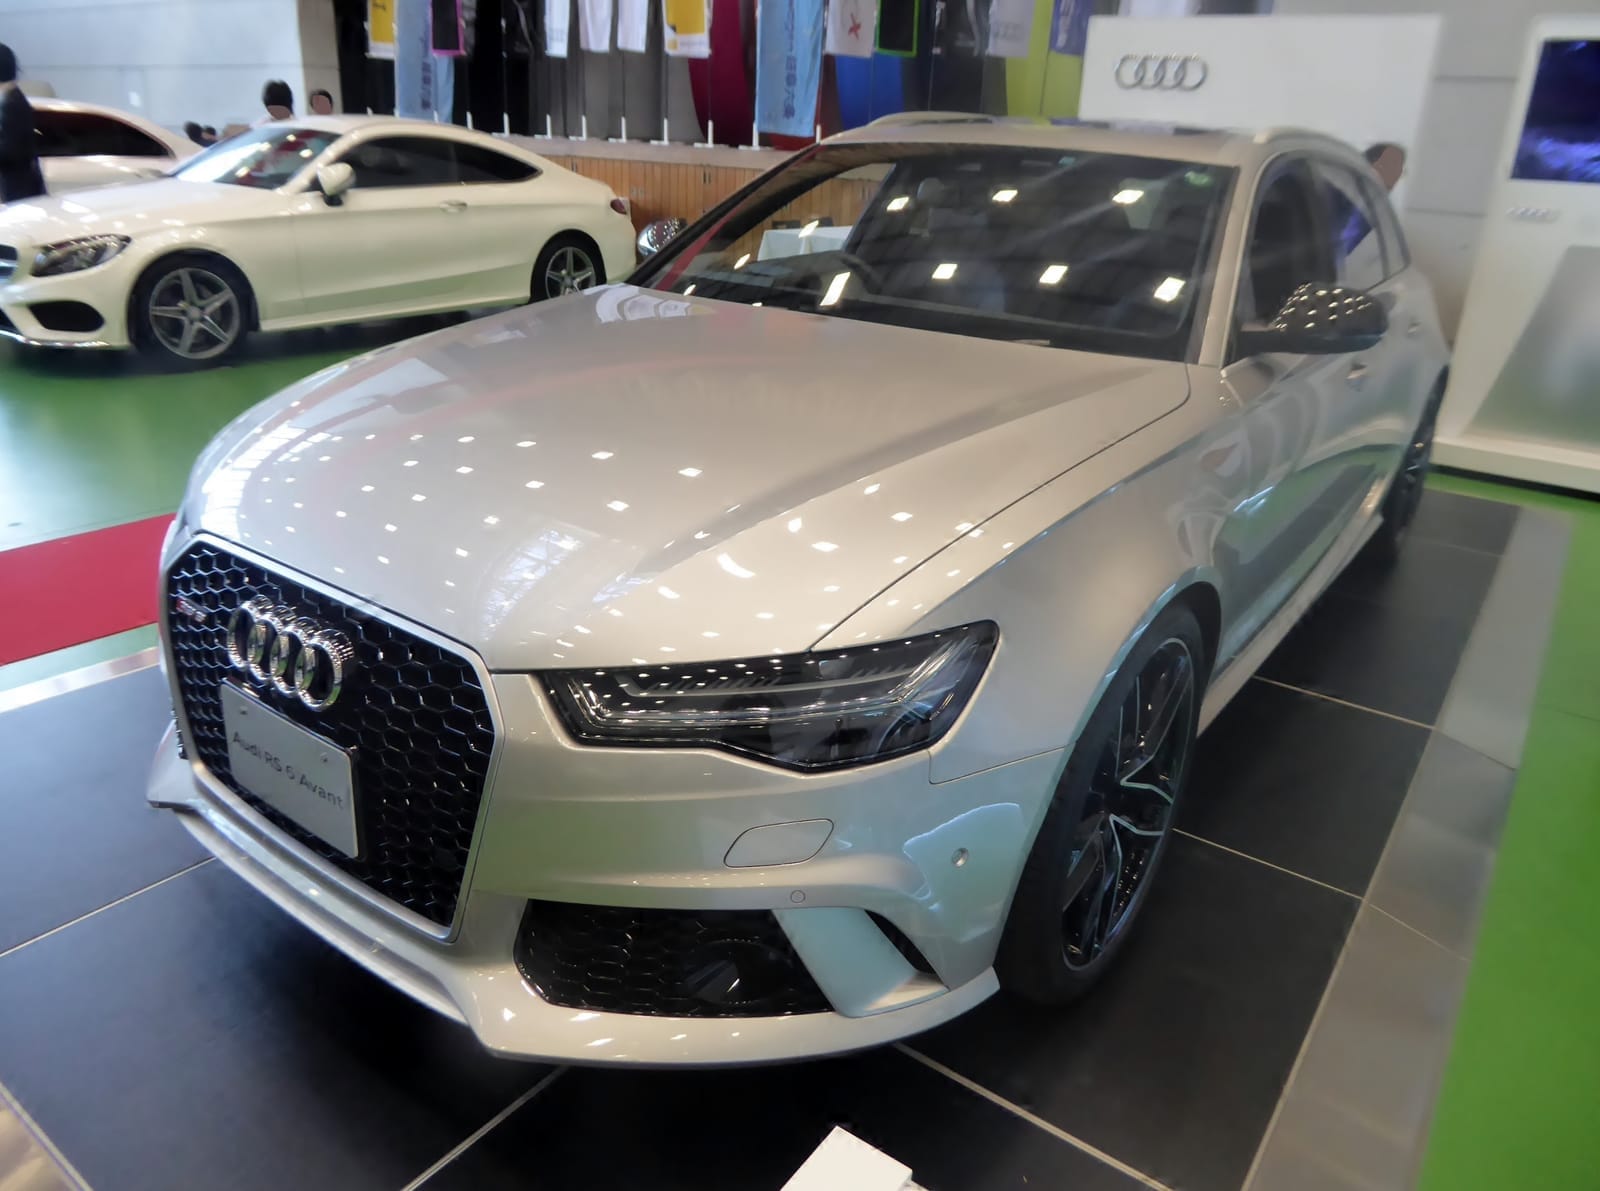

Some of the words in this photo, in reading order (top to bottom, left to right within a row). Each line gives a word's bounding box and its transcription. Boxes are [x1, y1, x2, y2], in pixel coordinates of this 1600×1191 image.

[232, 731, 262, 760] Audi
[264, 751, 282, 772] RS
[300, 774, 345, 808] Avant
